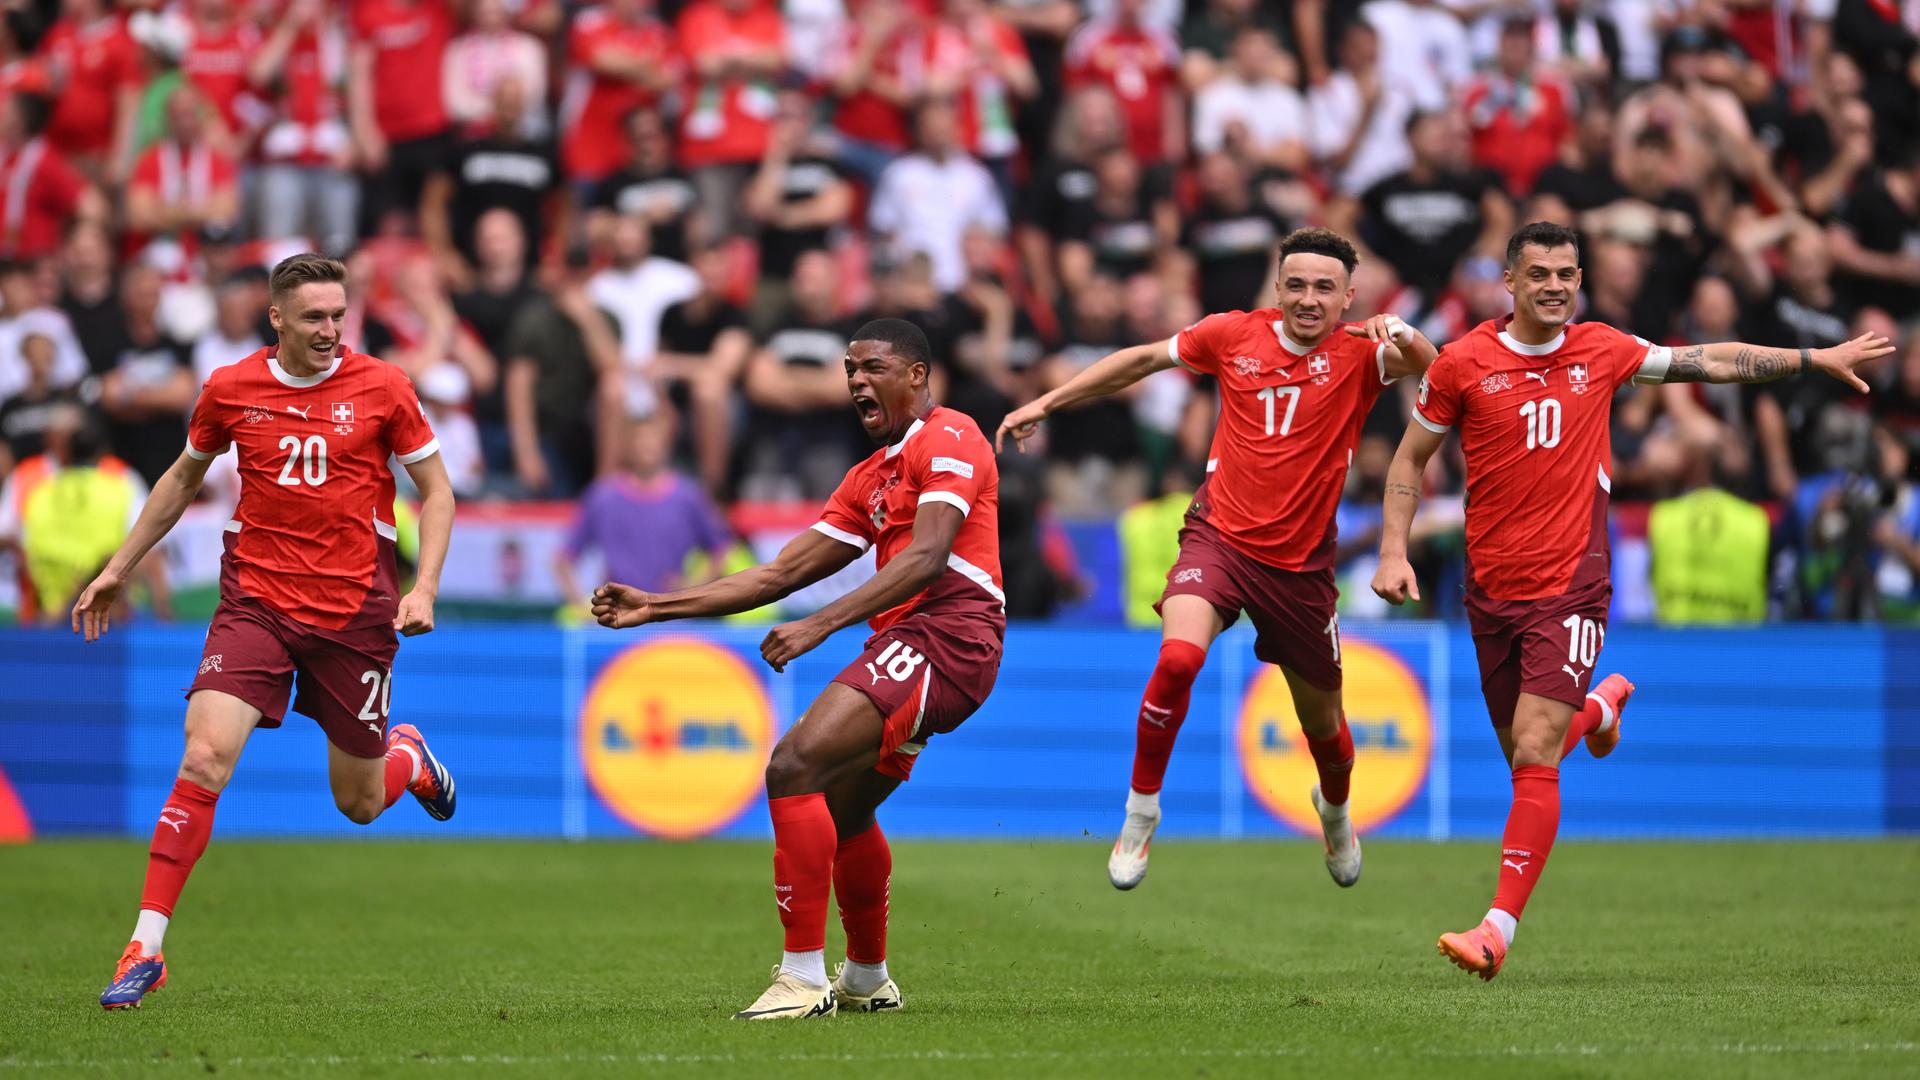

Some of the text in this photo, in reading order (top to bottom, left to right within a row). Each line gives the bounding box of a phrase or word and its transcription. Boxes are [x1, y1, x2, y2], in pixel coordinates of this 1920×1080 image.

[1257, 386, 1300, 436] 17
[1519, 398, 1561, 449] 10
[278, 435, 327, 486] 20
[875, 640, 925, 681] 18
[1324, 612, 1339, 661] 1
[1563, 614, 1596, 667] 10
